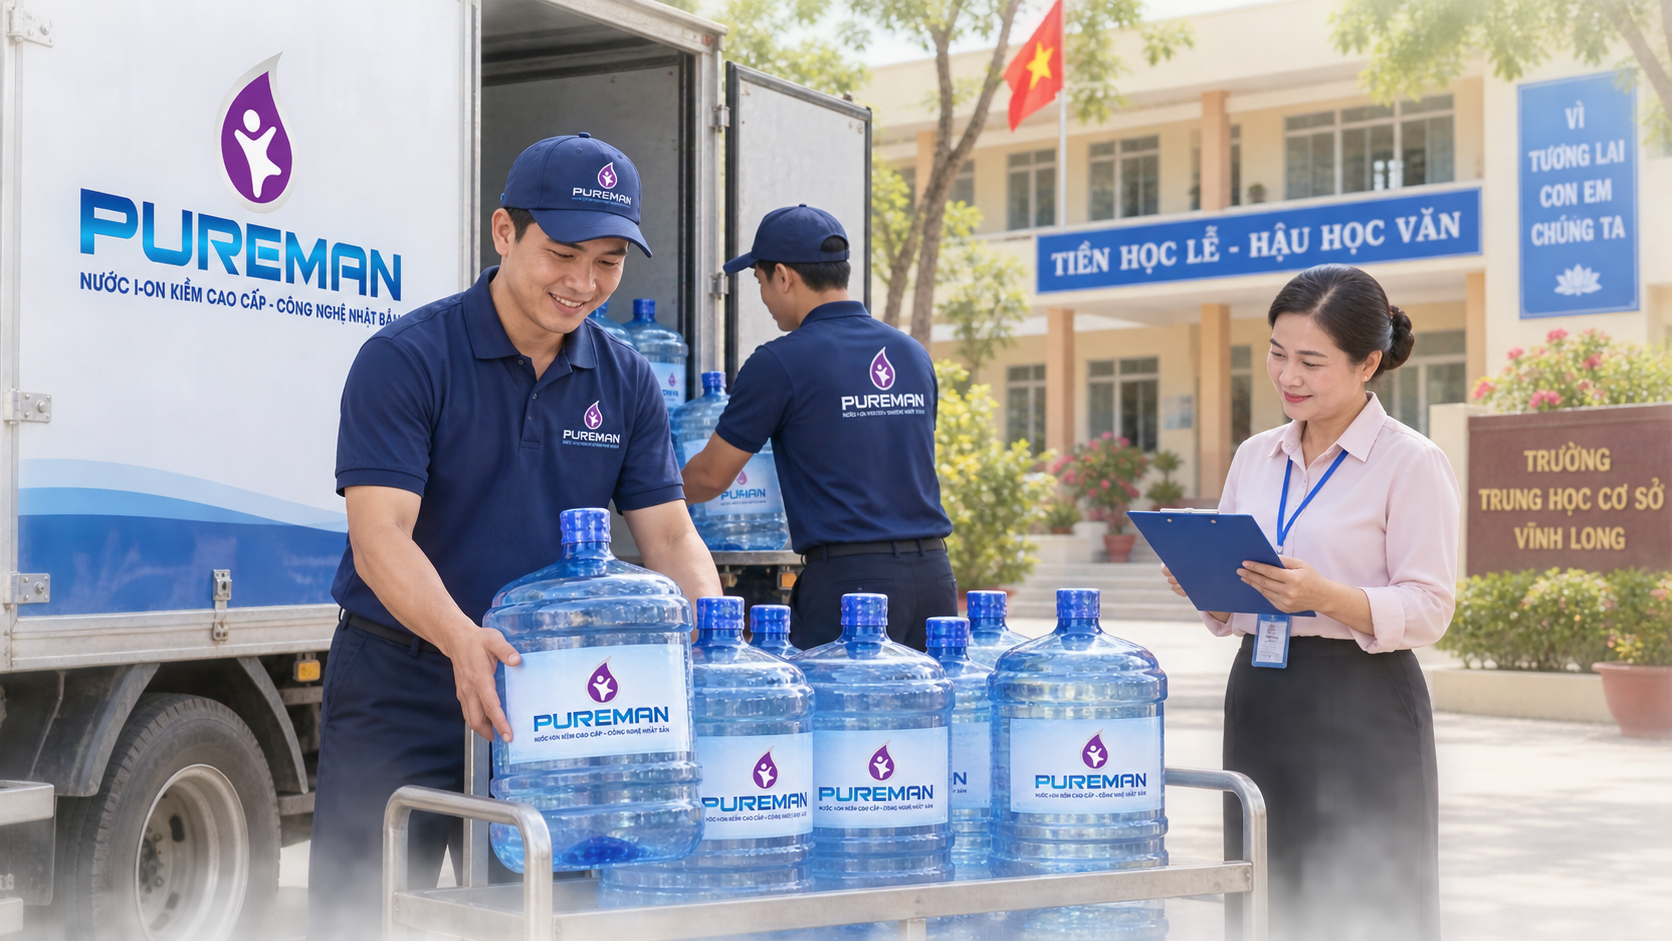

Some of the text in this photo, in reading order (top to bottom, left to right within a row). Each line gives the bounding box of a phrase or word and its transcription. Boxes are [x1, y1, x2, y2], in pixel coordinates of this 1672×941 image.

[1565, 99, 1585, 130] VÌ
[1528, 139, 1625, 173] TƯƠNG LAI
[572, 187, 632, 205] PUREMAN
[1540, 178, 1612, 208] CON EM
[80, 188, 401, 302] PUREMAN
[1051, 240, 1110, 277] TIỀN
[1119, 240, 1177, 275] HỌC
[1186, 225, 1220, 264] LỄ
[1249, 222, 1311, 262] HẬU
[1320, 219, 1385, 255] HỌC
[1395, 206, 1462, 243] VĂN
[1531, 214, 1626, 247] CHÚNG TA
[80, 271, 129, 294] NƯỚC
[134, 279, 165, 299] I-ON
[171, 277, 202, 303] KIỀM
[206, 288, 236, 307] CAO
[240, 288, 266, 311] CẤP
[276, 295, 313, 317] CÔNG
[316, 303, 346, 325] NGHỆ
[349, 307, 377, 328] NHẬT
[841, 393, 925, 411] PUREMAN
[563, 429, 620, 444] PUREMAN
[1523, 441, 1611, 473] TRƯỜNG
[1478, 477, 1666, 516] TRUNG HỌC CƠ SỞ
[1514, 522, 1626, 550] VĨNH LONG
[533, 706, 669, 732] PUREMAN
[818, 784, 933, 802] PUREMAN
[1035, 773, 1147, 790] PUREMAN
[701, 791, 808, 812] PUREMAN
